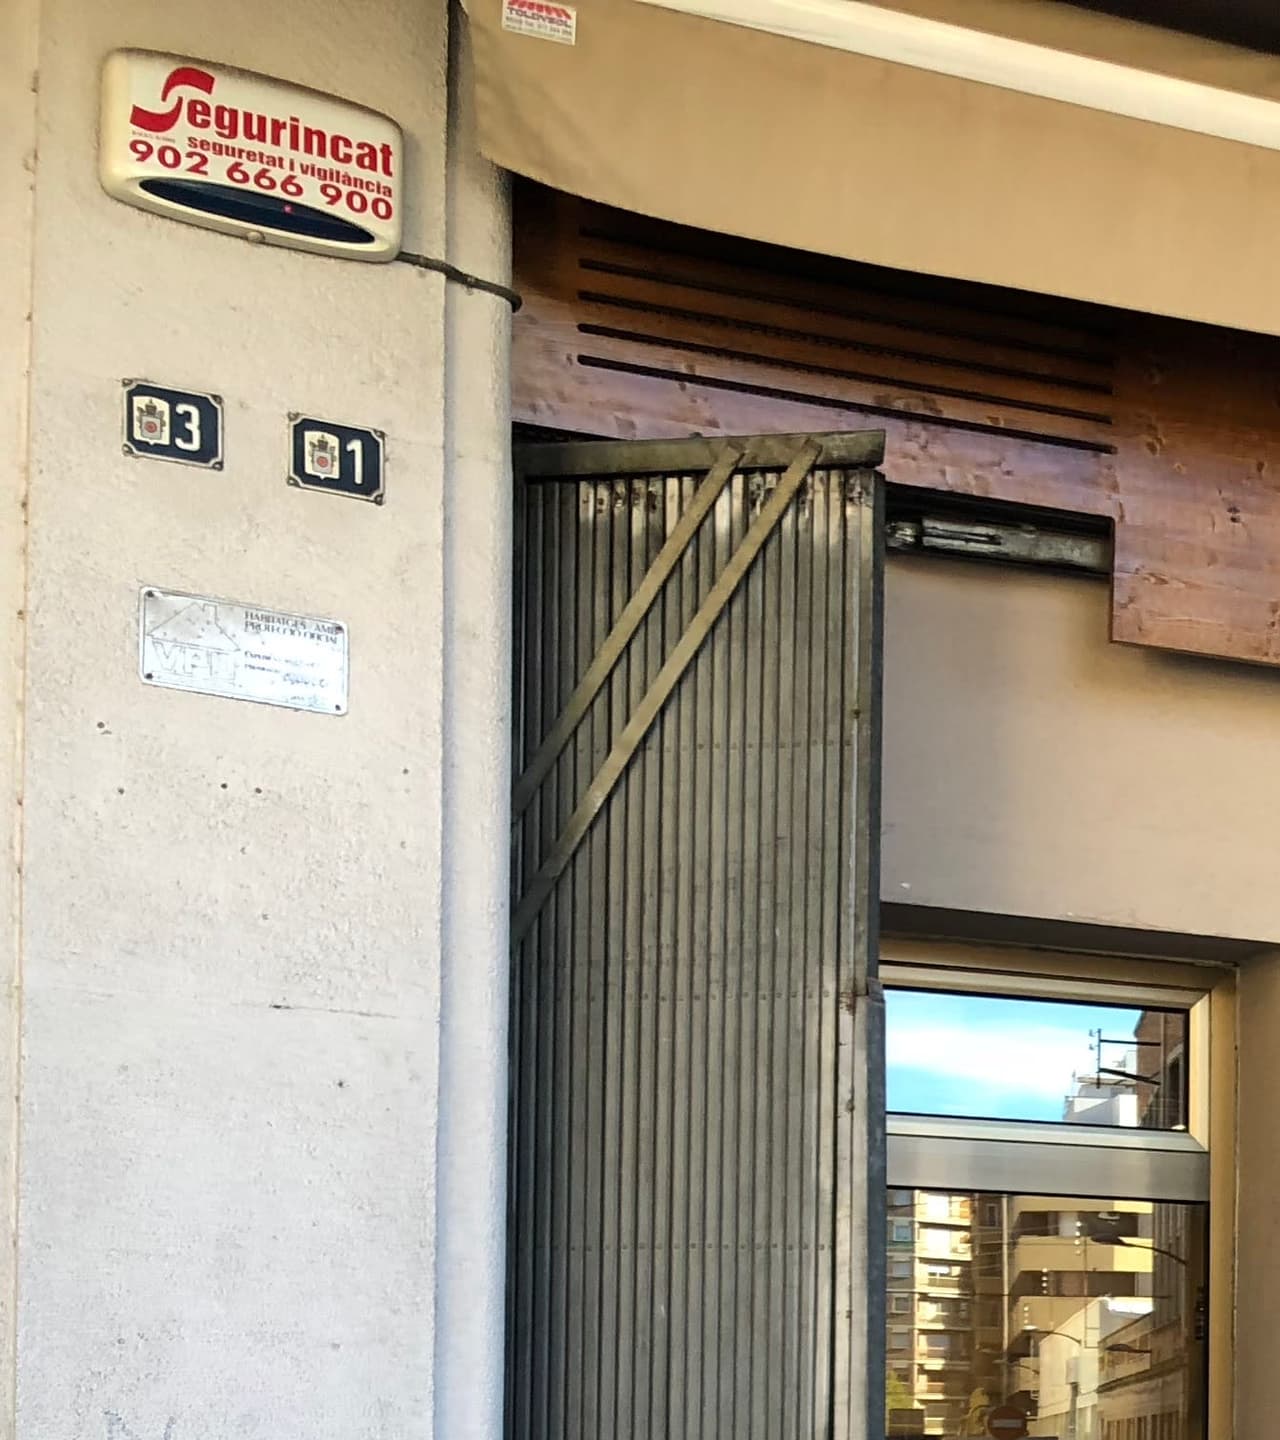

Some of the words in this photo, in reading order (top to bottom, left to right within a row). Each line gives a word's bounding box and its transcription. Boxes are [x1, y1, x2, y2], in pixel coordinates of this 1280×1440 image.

[130, 67, 393, 177] Segurincat
[129, 139, 209, 176] 902
[226, 162, 304, 197] 666
[320, 184, 393, 220] 900
[187, 136, 284, 170] seguretat
[288, 158, 295, 171] i
[300, 163, 393, 198] vigilància
[174, 403, 201, 451] 3
[346, 440, 363, 485] 1
